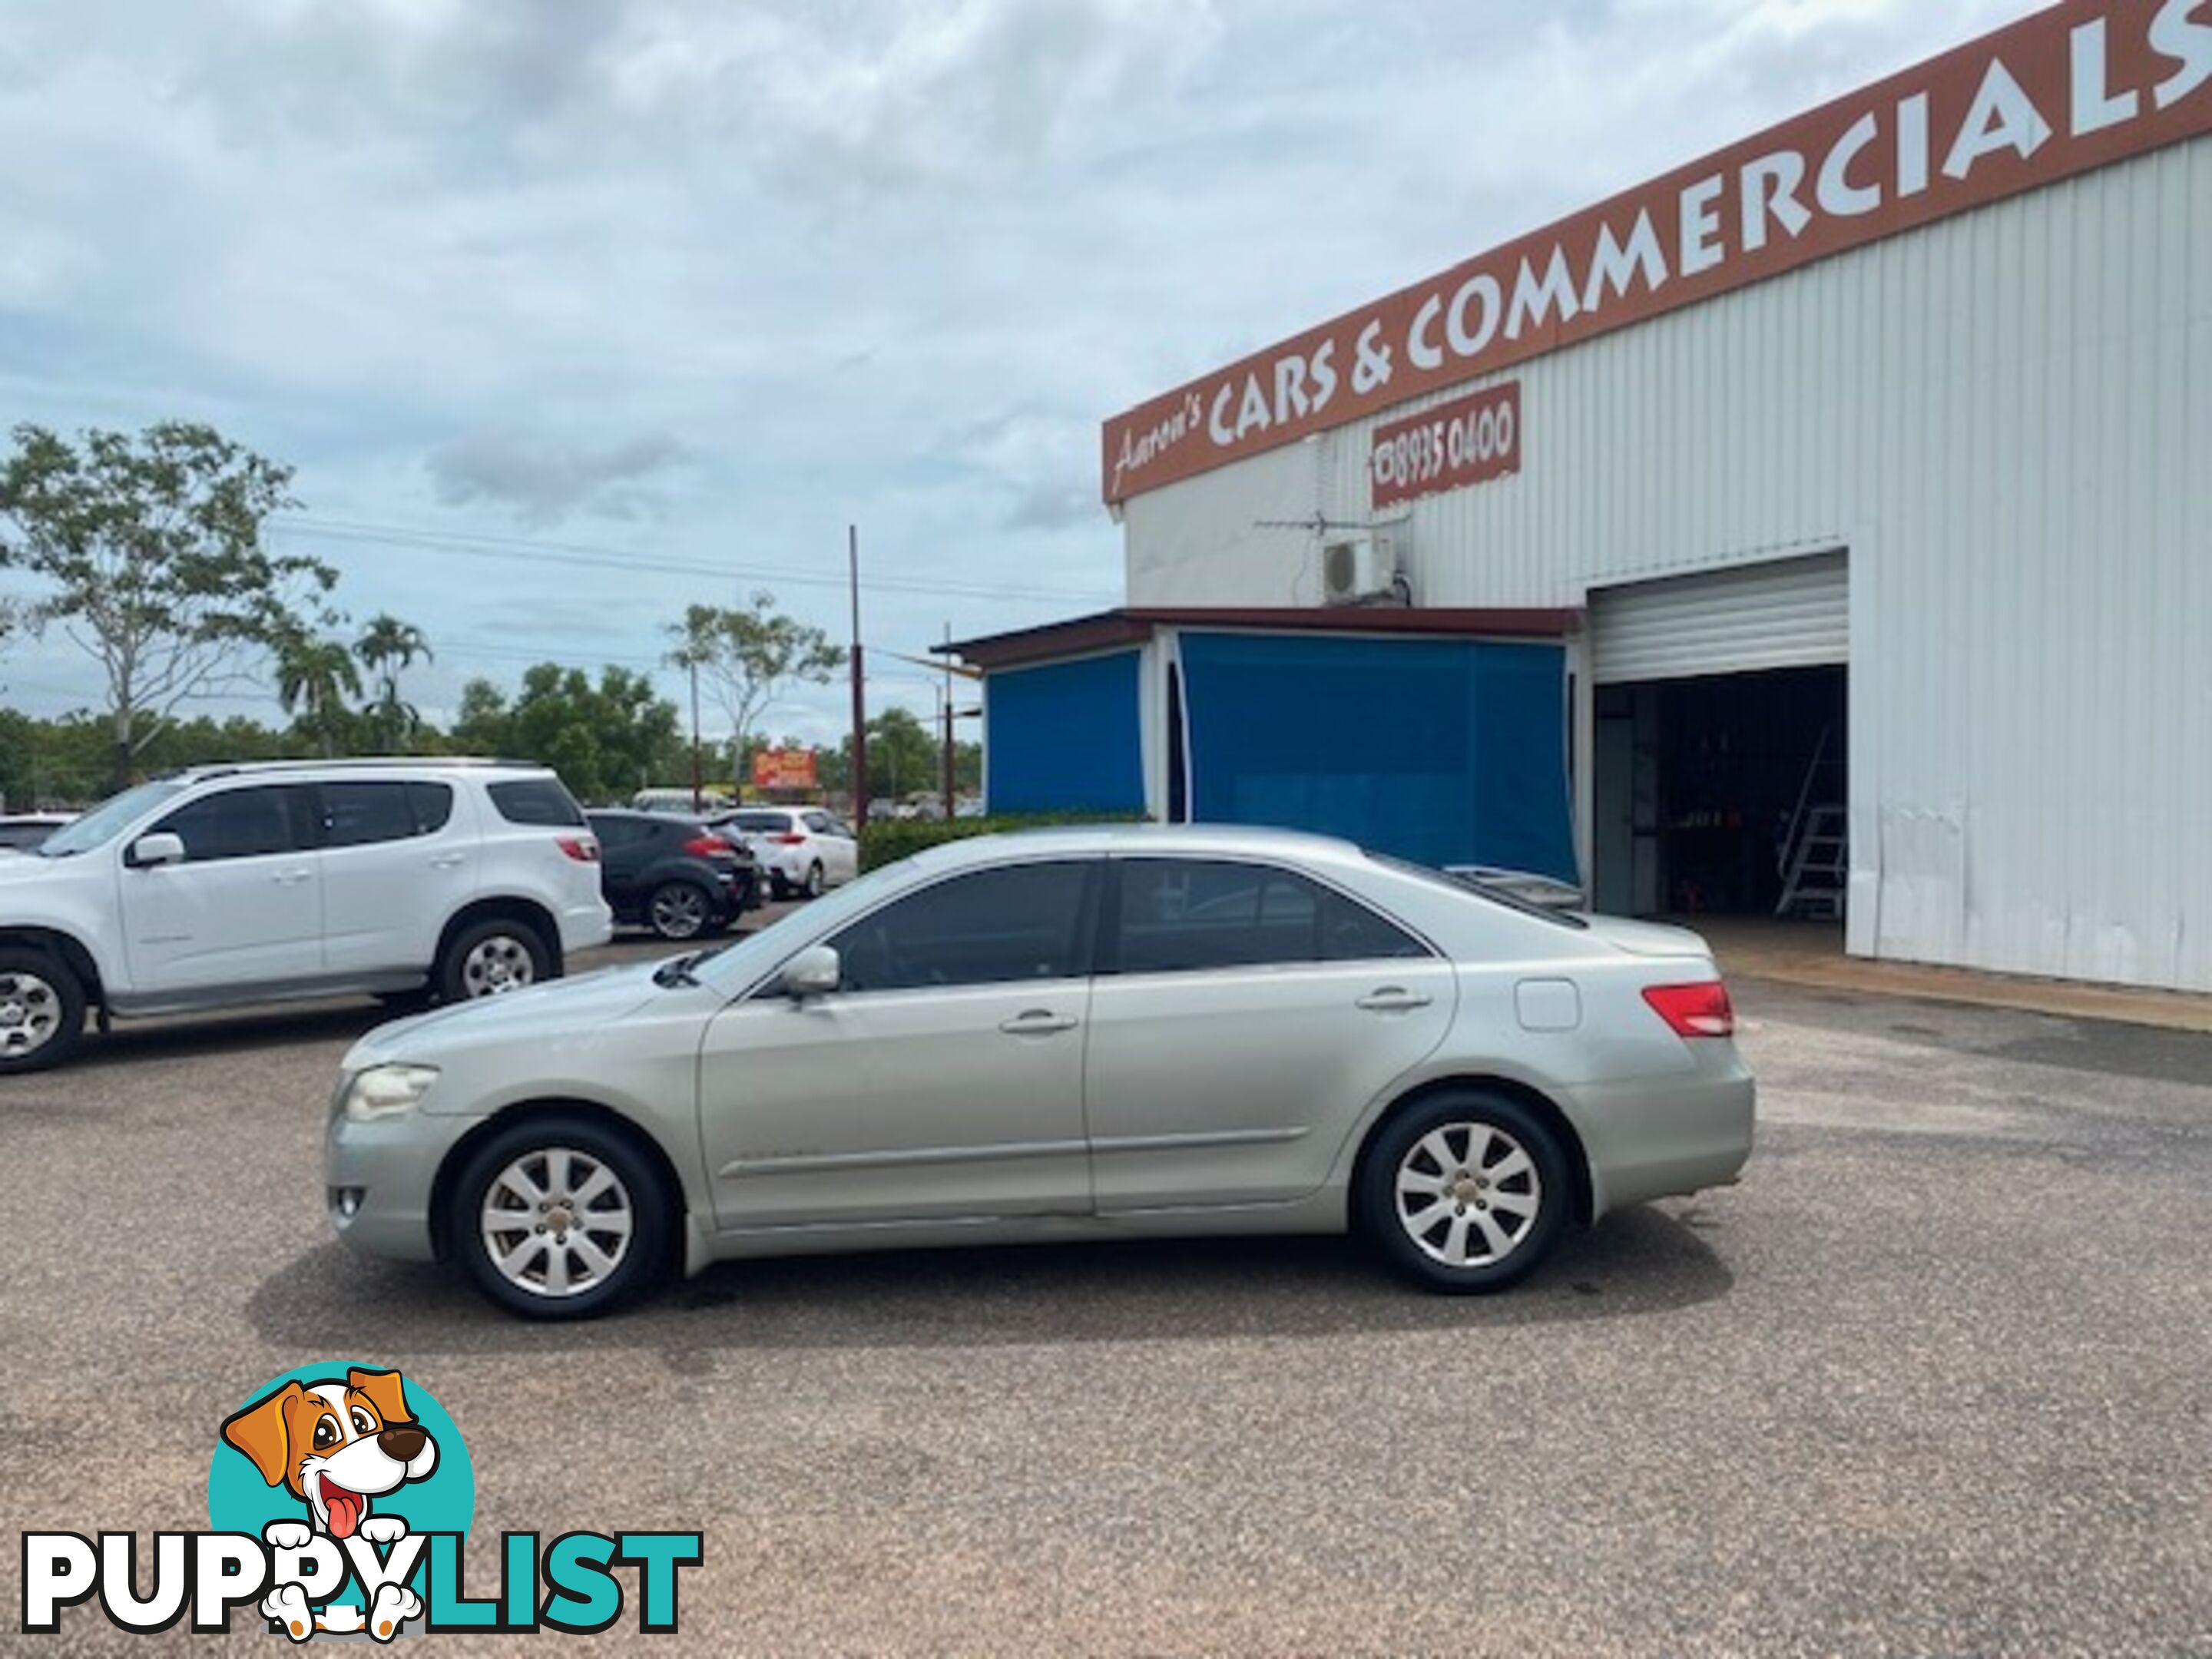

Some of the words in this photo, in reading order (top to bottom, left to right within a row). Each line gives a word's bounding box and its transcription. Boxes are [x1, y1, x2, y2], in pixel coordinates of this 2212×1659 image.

[1112, 392, 1201, 496] Aaron's
[1208, 338, 1336, 445] CARS
[1351, 318, 1392, 395] &
[1406, 0, 2212, 371] COMMERCIALS
[1448, 399, 1515, 471] 0400
